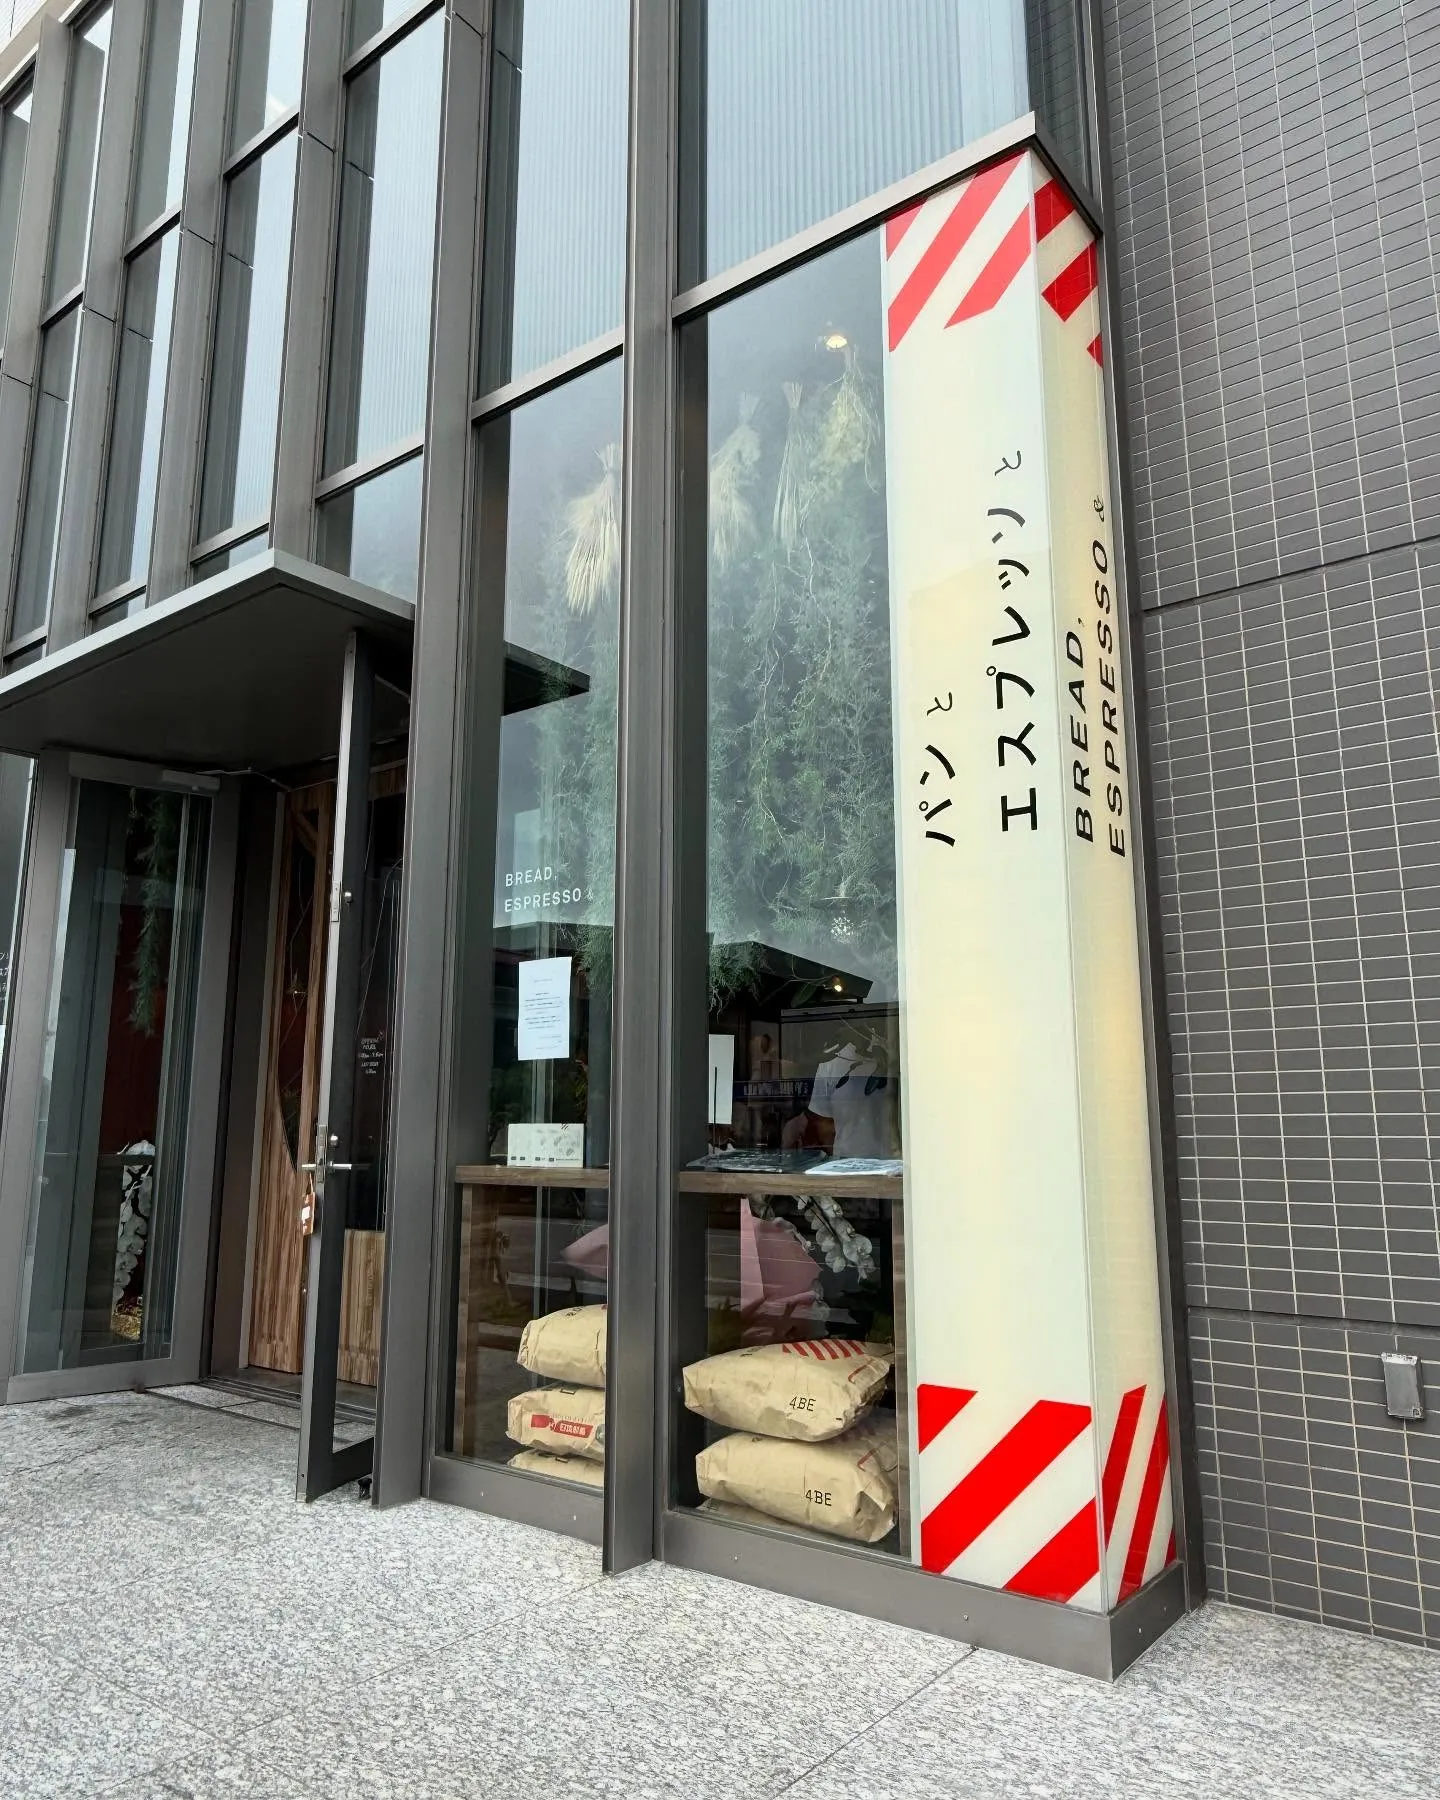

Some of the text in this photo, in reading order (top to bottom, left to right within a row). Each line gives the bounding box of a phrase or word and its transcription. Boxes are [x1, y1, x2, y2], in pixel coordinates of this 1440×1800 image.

[1092, 494, 1126, 858] ESPRESSO &
[1066, 617, 1094, 843] BREAD,
[504, 887, 582, 913] ESPRESSO
[789, 1396, 816, 1412] 4BE
[805, 1489, 832, 1507] 4BE
